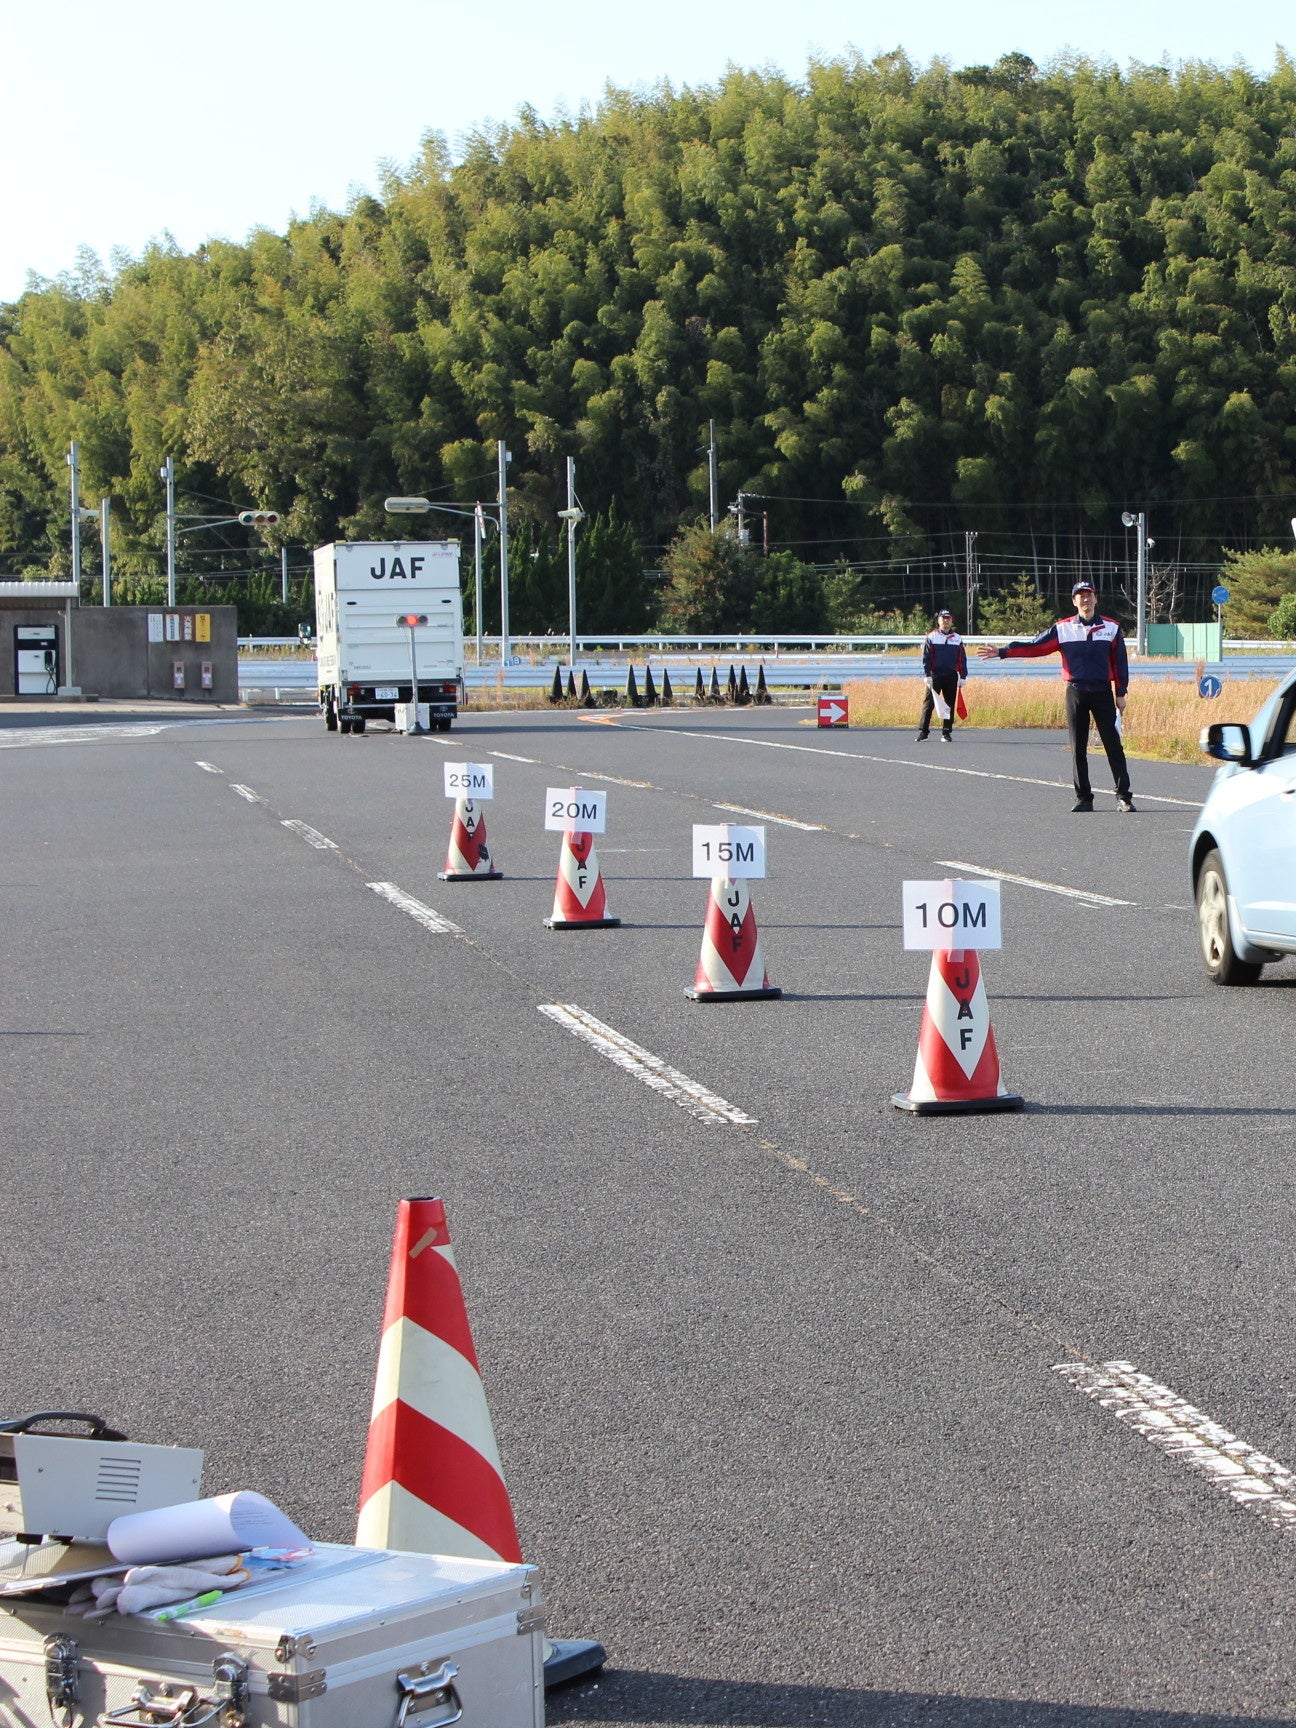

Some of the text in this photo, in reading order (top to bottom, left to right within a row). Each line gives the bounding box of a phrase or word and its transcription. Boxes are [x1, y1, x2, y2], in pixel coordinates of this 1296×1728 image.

[370, 557, 425, 580] JAF
[1204, 678, 1212, 697] 1
[449, 774, 486, 788] 25M
[552, 801, 598, 820] 20M
[701, 841, 754, 862] 15M
[727, 890, 743, 952] JAF
[915, 902, 987, 928] 10M
[955, 968, 974, 1050] JAF
